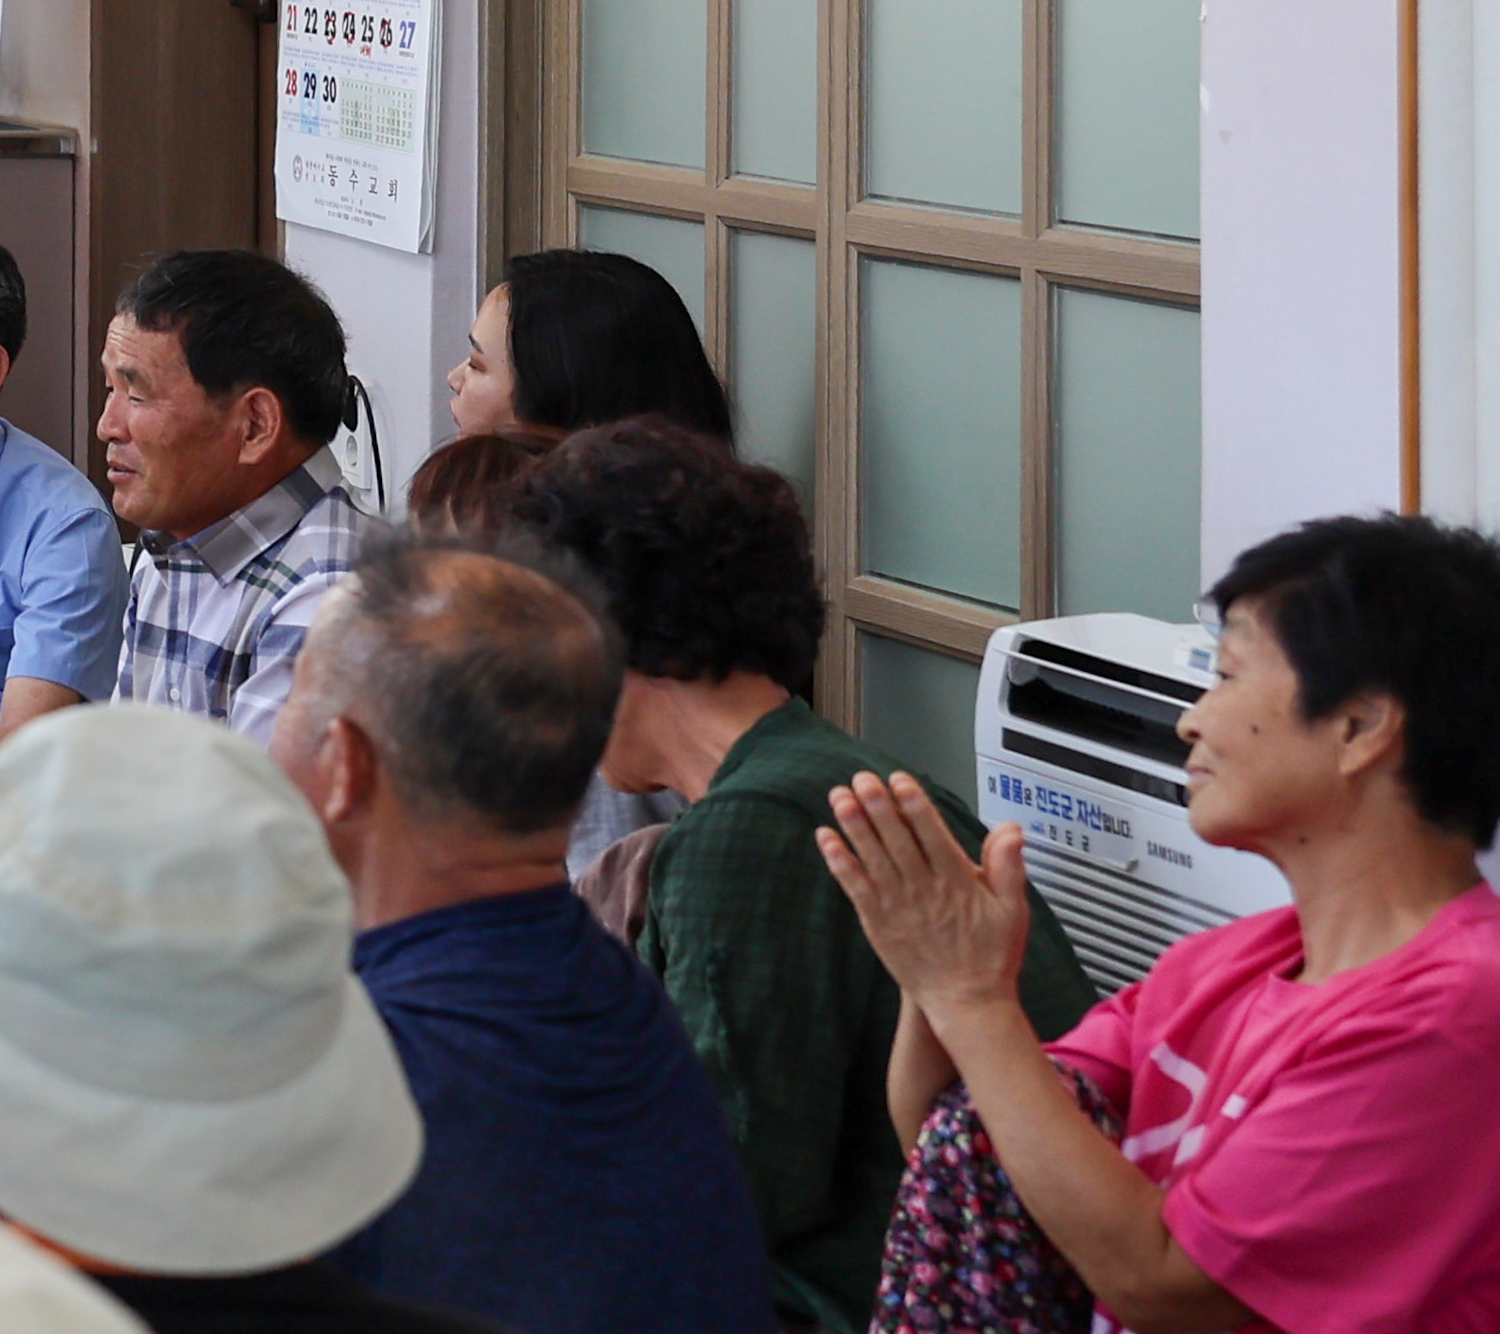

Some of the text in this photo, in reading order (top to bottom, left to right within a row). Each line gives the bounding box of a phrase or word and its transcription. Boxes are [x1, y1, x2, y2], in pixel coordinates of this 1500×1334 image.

[286, 4, 297, 32] 21
[304, 6, 318, 35] 22
[361, 14, 375, 44] 25
[399, 20, 417, 50] 27
[285, 68, 337, 104] 28 29 30
[987, 776, 997, 794] 이
[999, 773, 1032, 807] 물품은
[1034, 785, 1074, 821] 진도군
[1075, 798, 1134, 840] 자산입니다.
[1146, 840, 1194, 869] SAMSUNG
